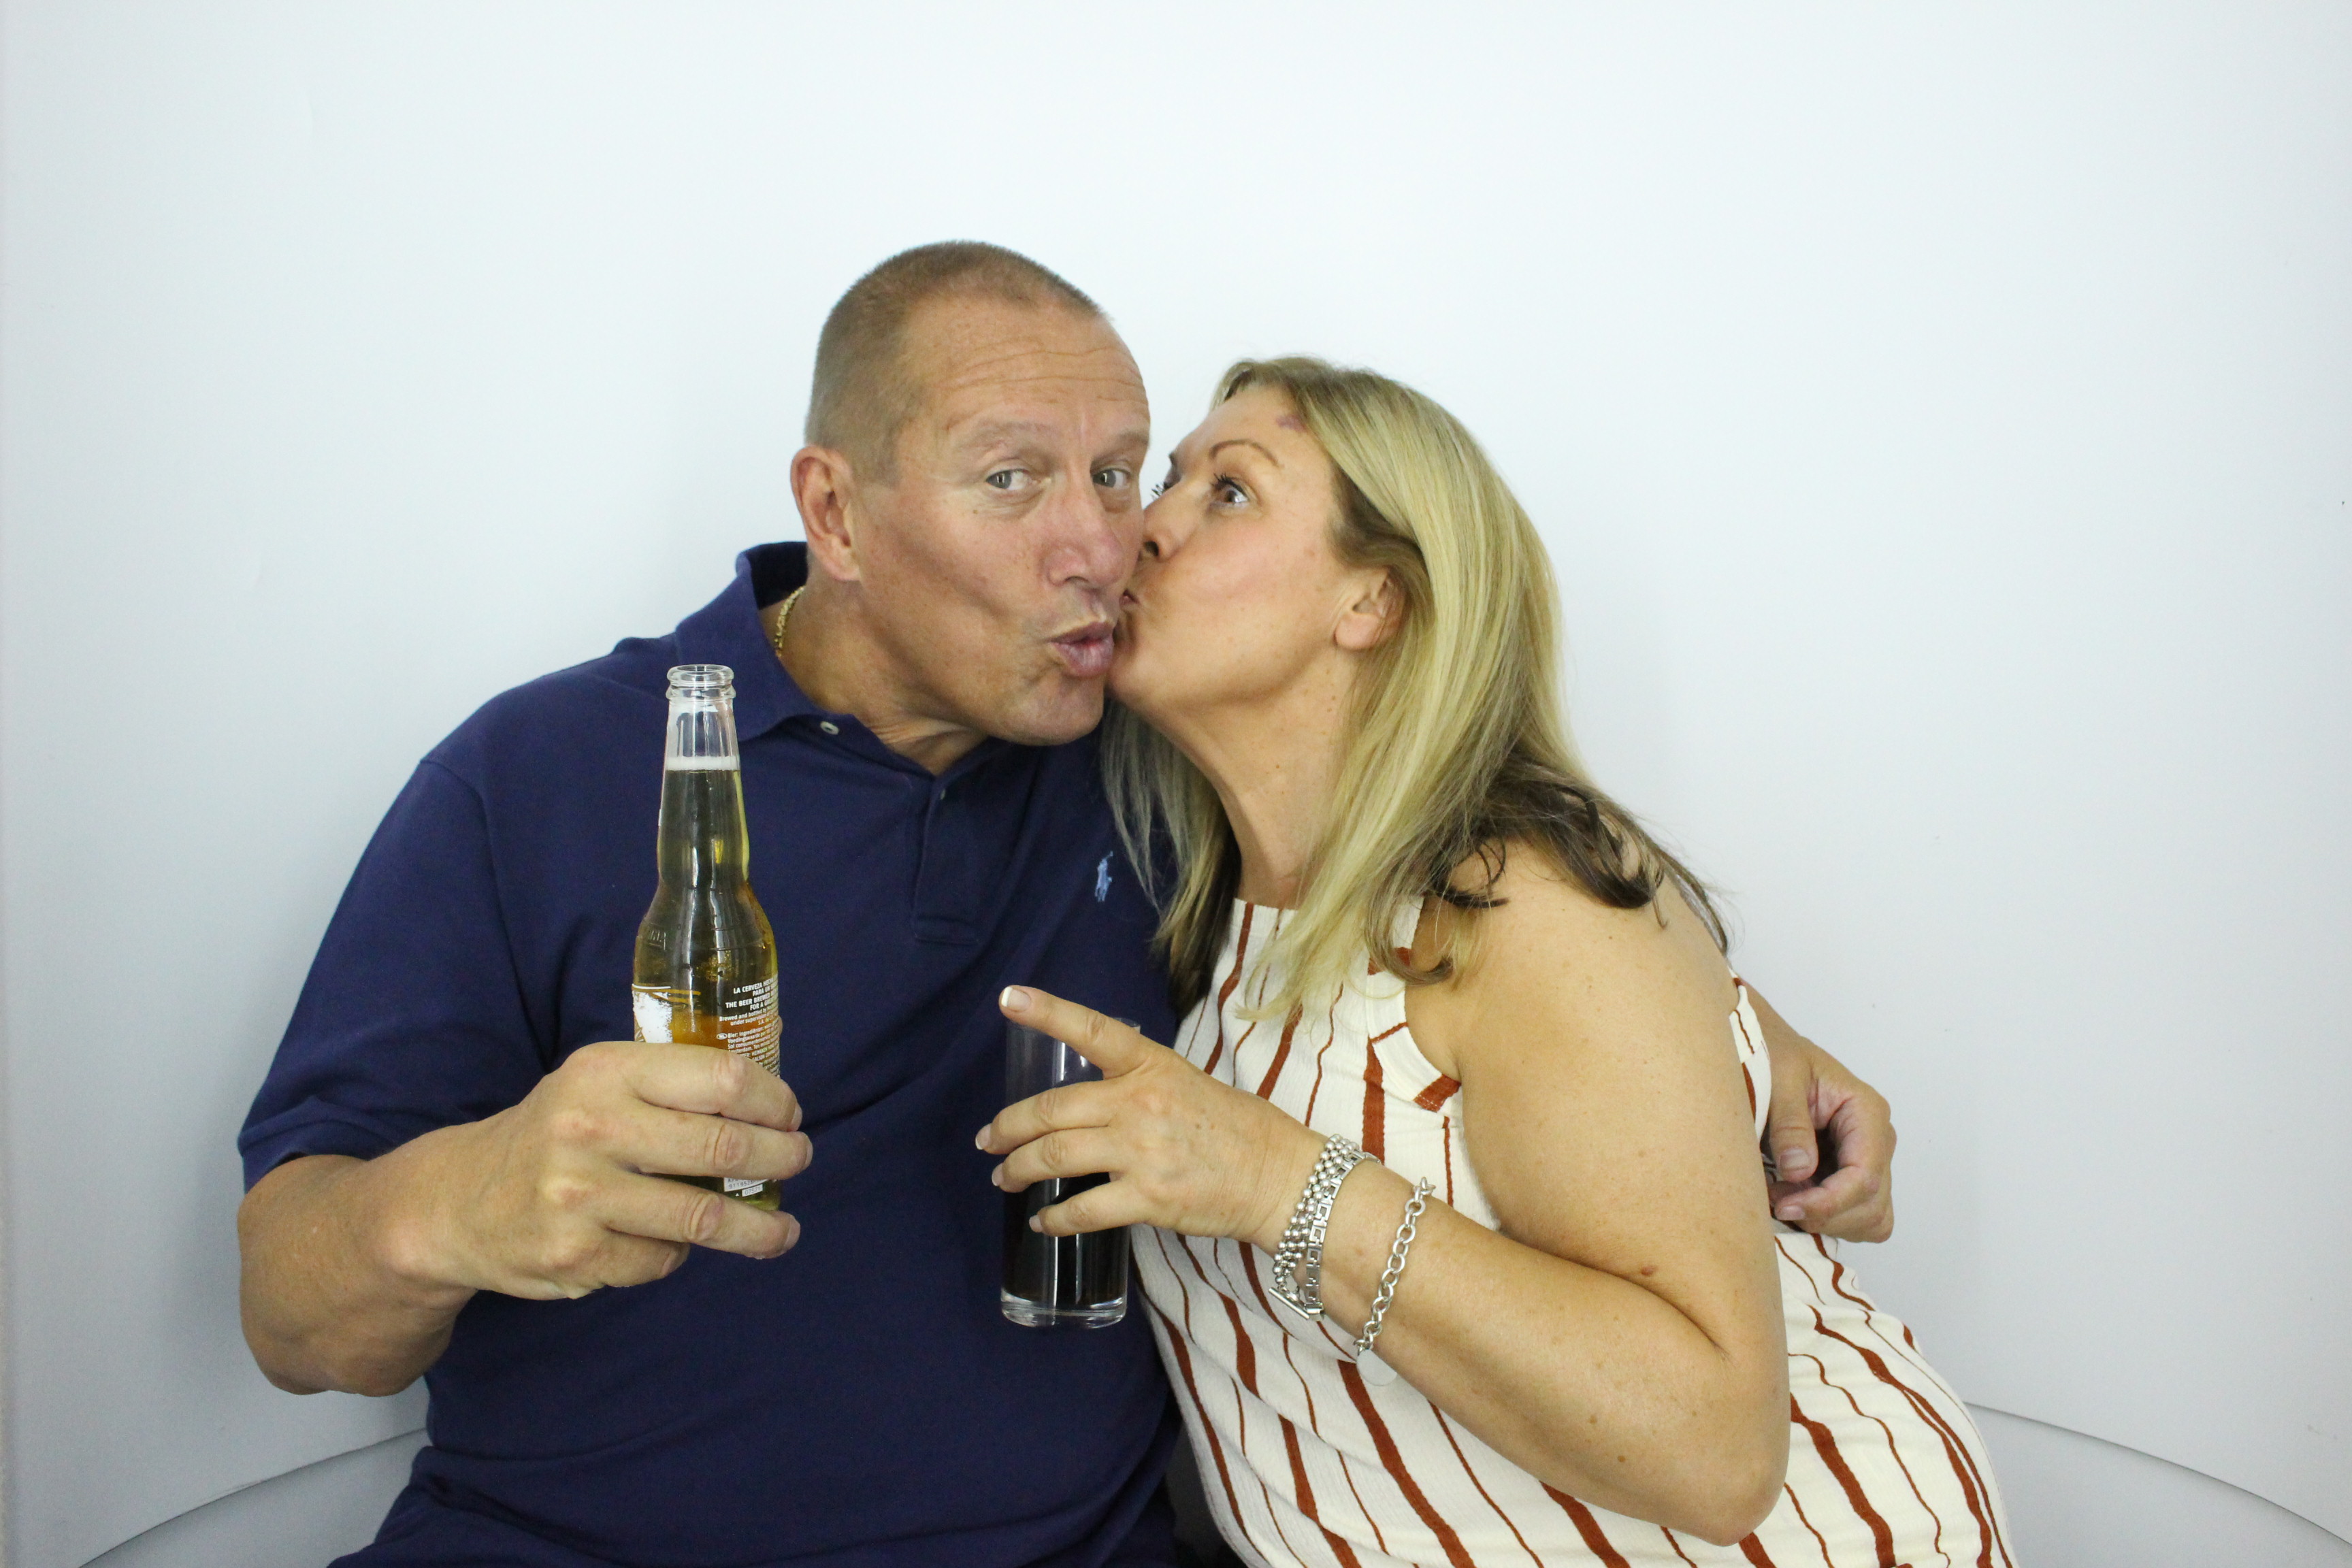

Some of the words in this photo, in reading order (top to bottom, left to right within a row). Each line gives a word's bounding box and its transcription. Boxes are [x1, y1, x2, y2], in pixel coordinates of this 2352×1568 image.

[742, 982, 763, 993] CERVEZA
[753, 988, 764, 996] PARA
[738, 998, 753, 1007] BEER
